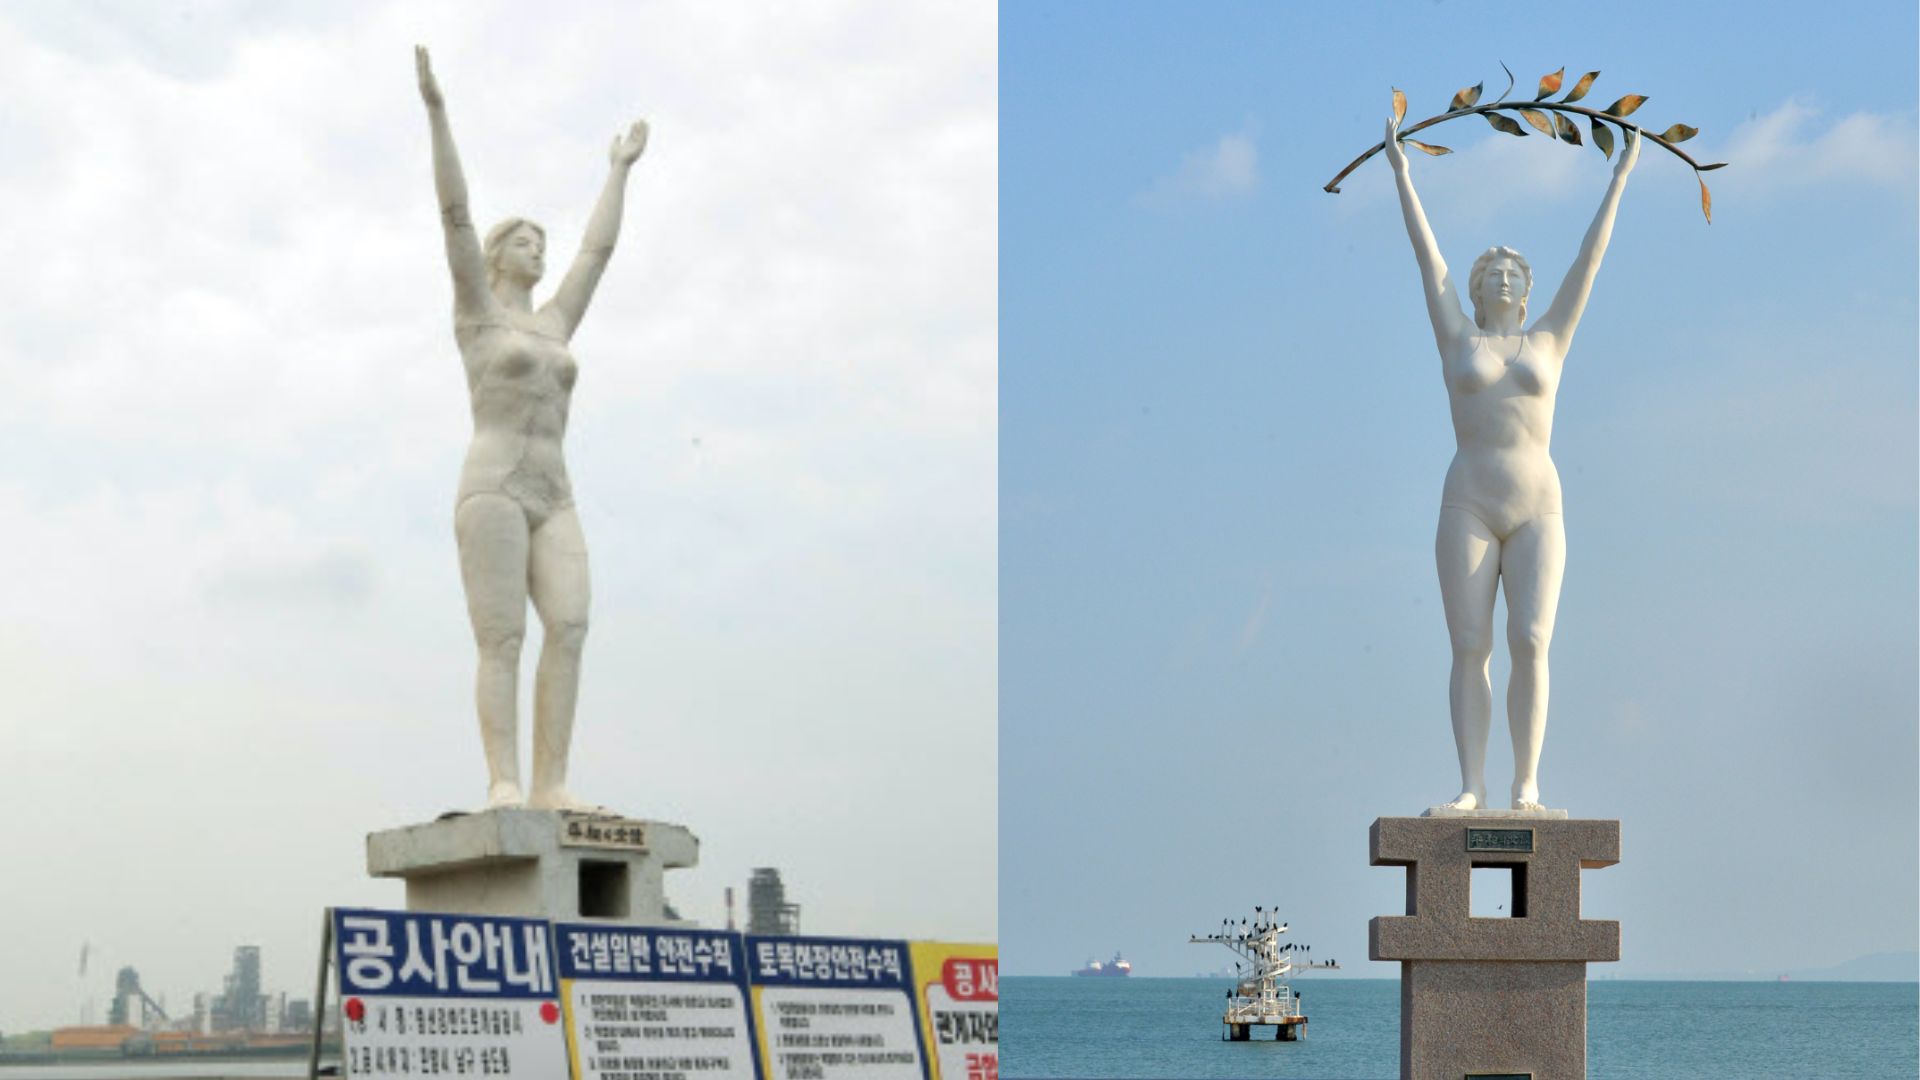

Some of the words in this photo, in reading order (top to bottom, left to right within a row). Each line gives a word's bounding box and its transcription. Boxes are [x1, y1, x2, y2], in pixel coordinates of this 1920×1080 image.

[343, 916, 552, 993] 공사안내
[568, 931, 651, 973] 건설일반
[655, 936, 734, 976] 안전수칙
[756, 941, 902, 982] 토목현장안전수칙
